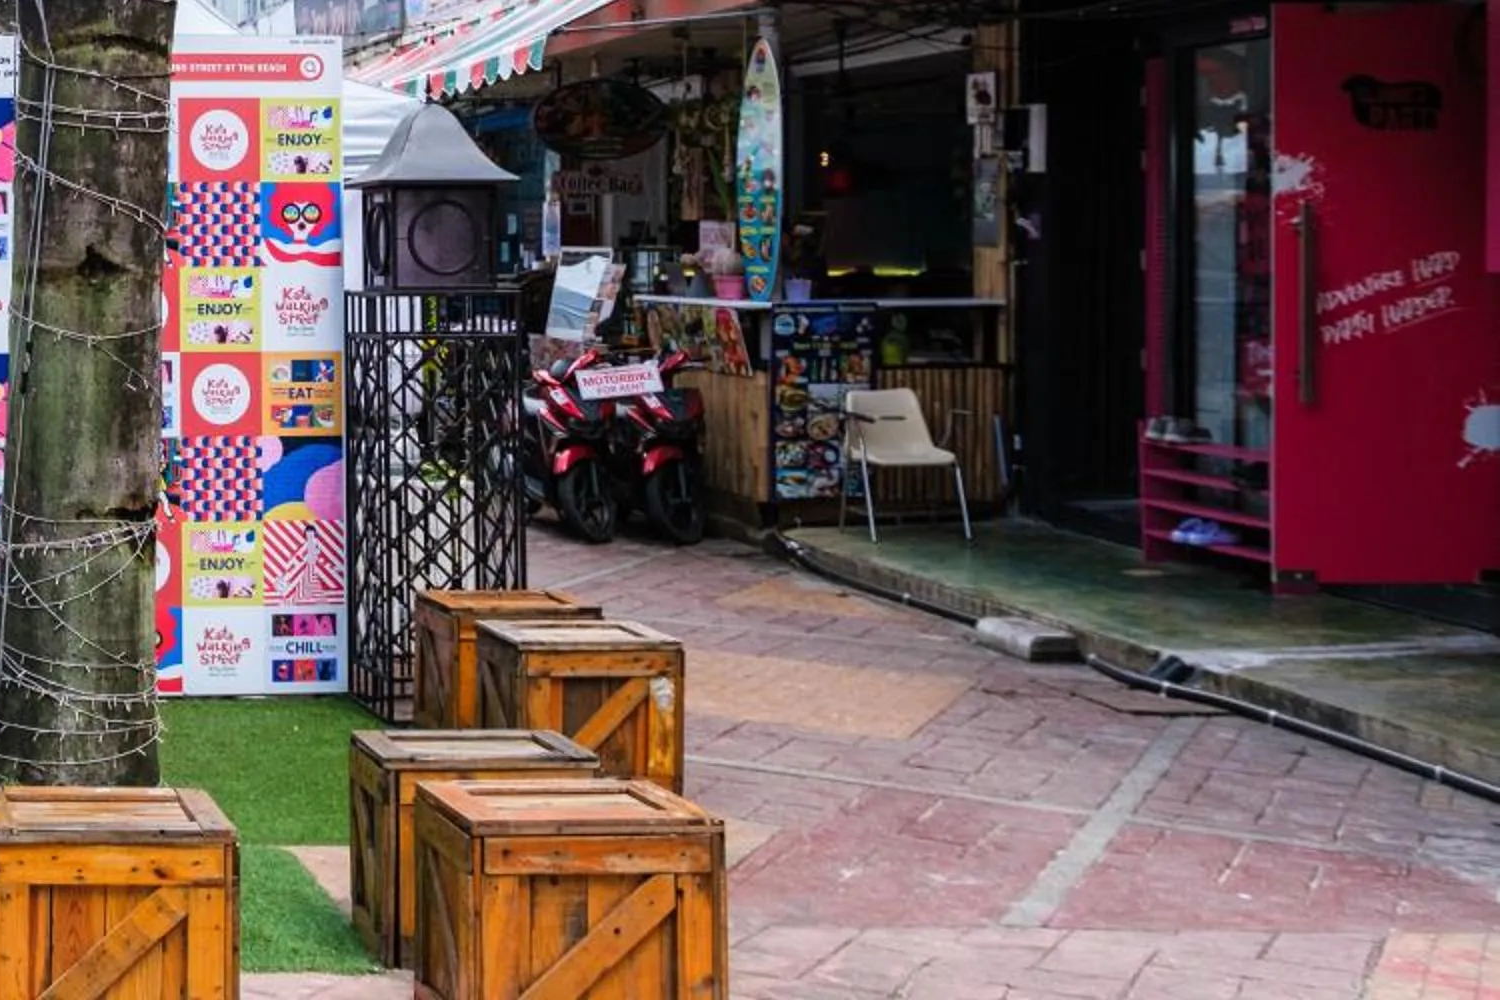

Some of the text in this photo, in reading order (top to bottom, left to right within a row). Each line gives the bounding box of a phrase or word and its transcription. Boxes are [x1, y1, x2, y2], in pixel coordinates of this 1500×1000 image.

[190, 63, 222, 73] STREET
[238, 63, 255, 73] THE
[277, 133, 322, 146] ENJOY
[197, 303, 243, 315] ENJOY
[288, 387, 314, 400] EAT
[199, 557, 245, 571] ENJOY
[285, 641, 323, 654] CHILL
